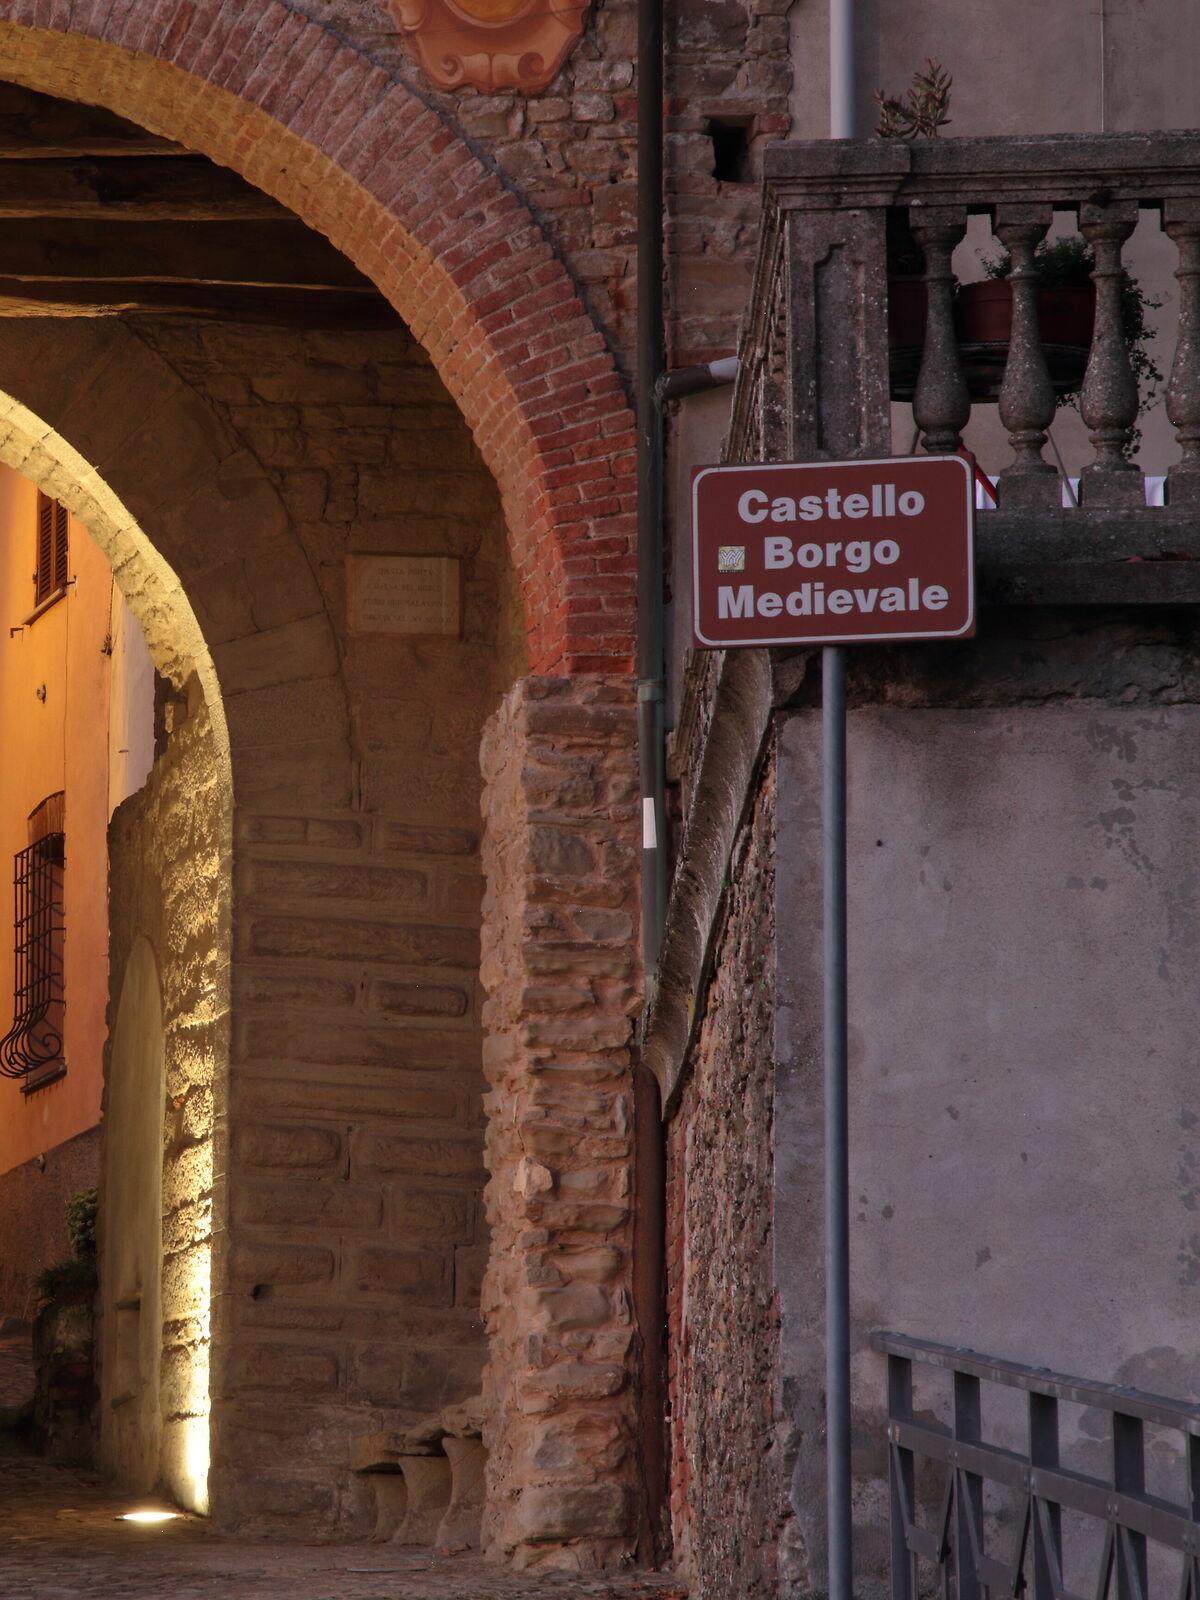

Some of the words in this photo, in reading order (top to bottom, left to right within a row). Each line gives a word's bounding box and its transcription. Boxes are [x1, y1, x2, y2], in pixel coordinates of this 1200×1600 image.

[737, 483, 925, 524] Castello
[764, 536, 900, 573] Borgo
[718, 577, 949, 619] Medievale
